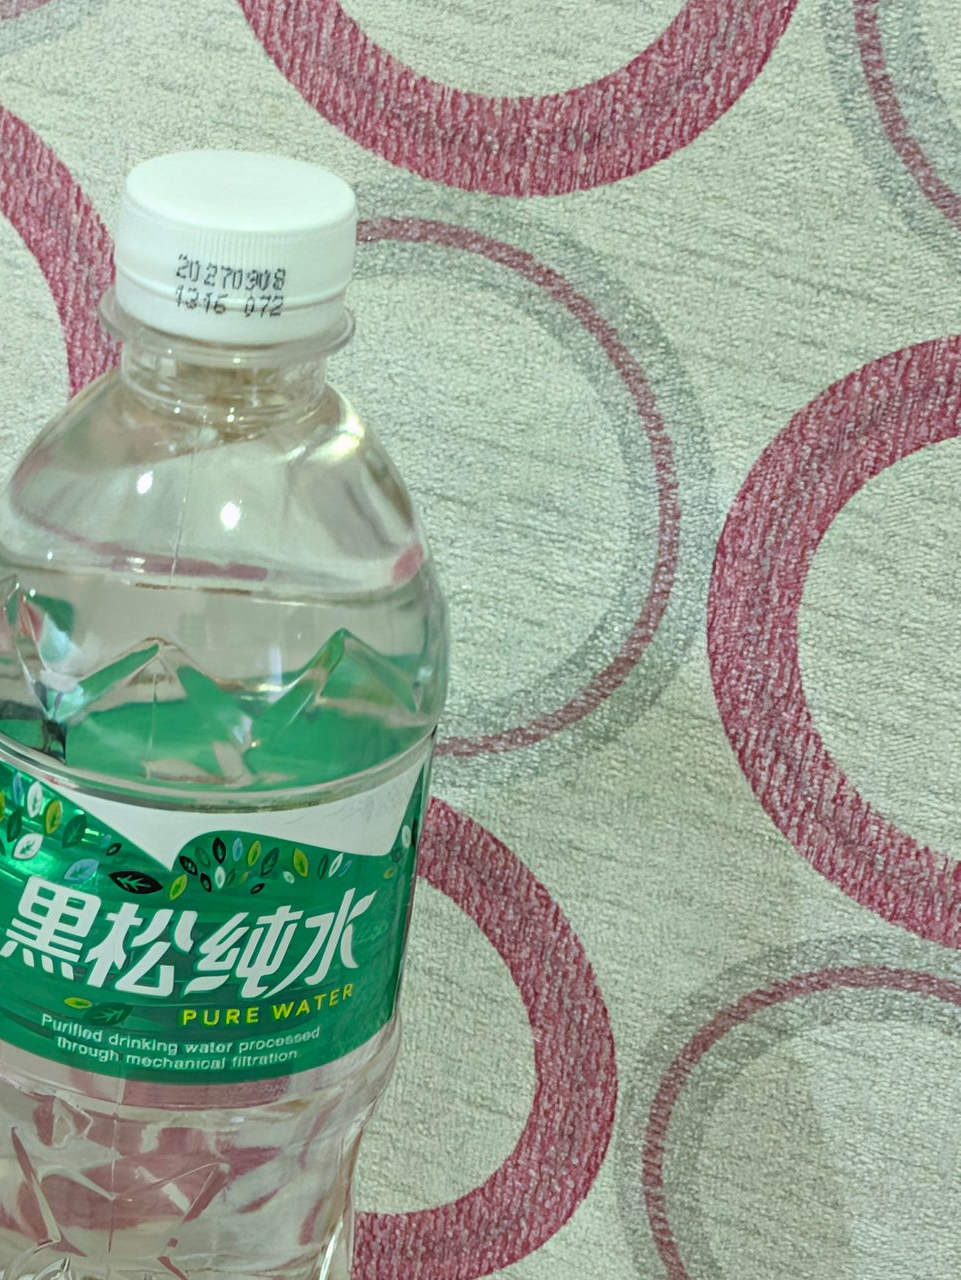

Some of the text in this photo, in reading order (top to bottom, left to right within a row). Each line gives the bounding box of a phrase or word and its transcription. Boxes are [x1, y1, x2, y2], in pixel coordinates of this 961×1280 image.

[176, 254, 286, 291] 20270908
[244, 295, 284, 317] 072
[182, 983, 354, 1026] PURE WATER
[41, 1012, 321, 1056] Purified drinking water processed
[57, 1034, 120, 1064] through
[125, 1053, 226, 1071] mechanical
